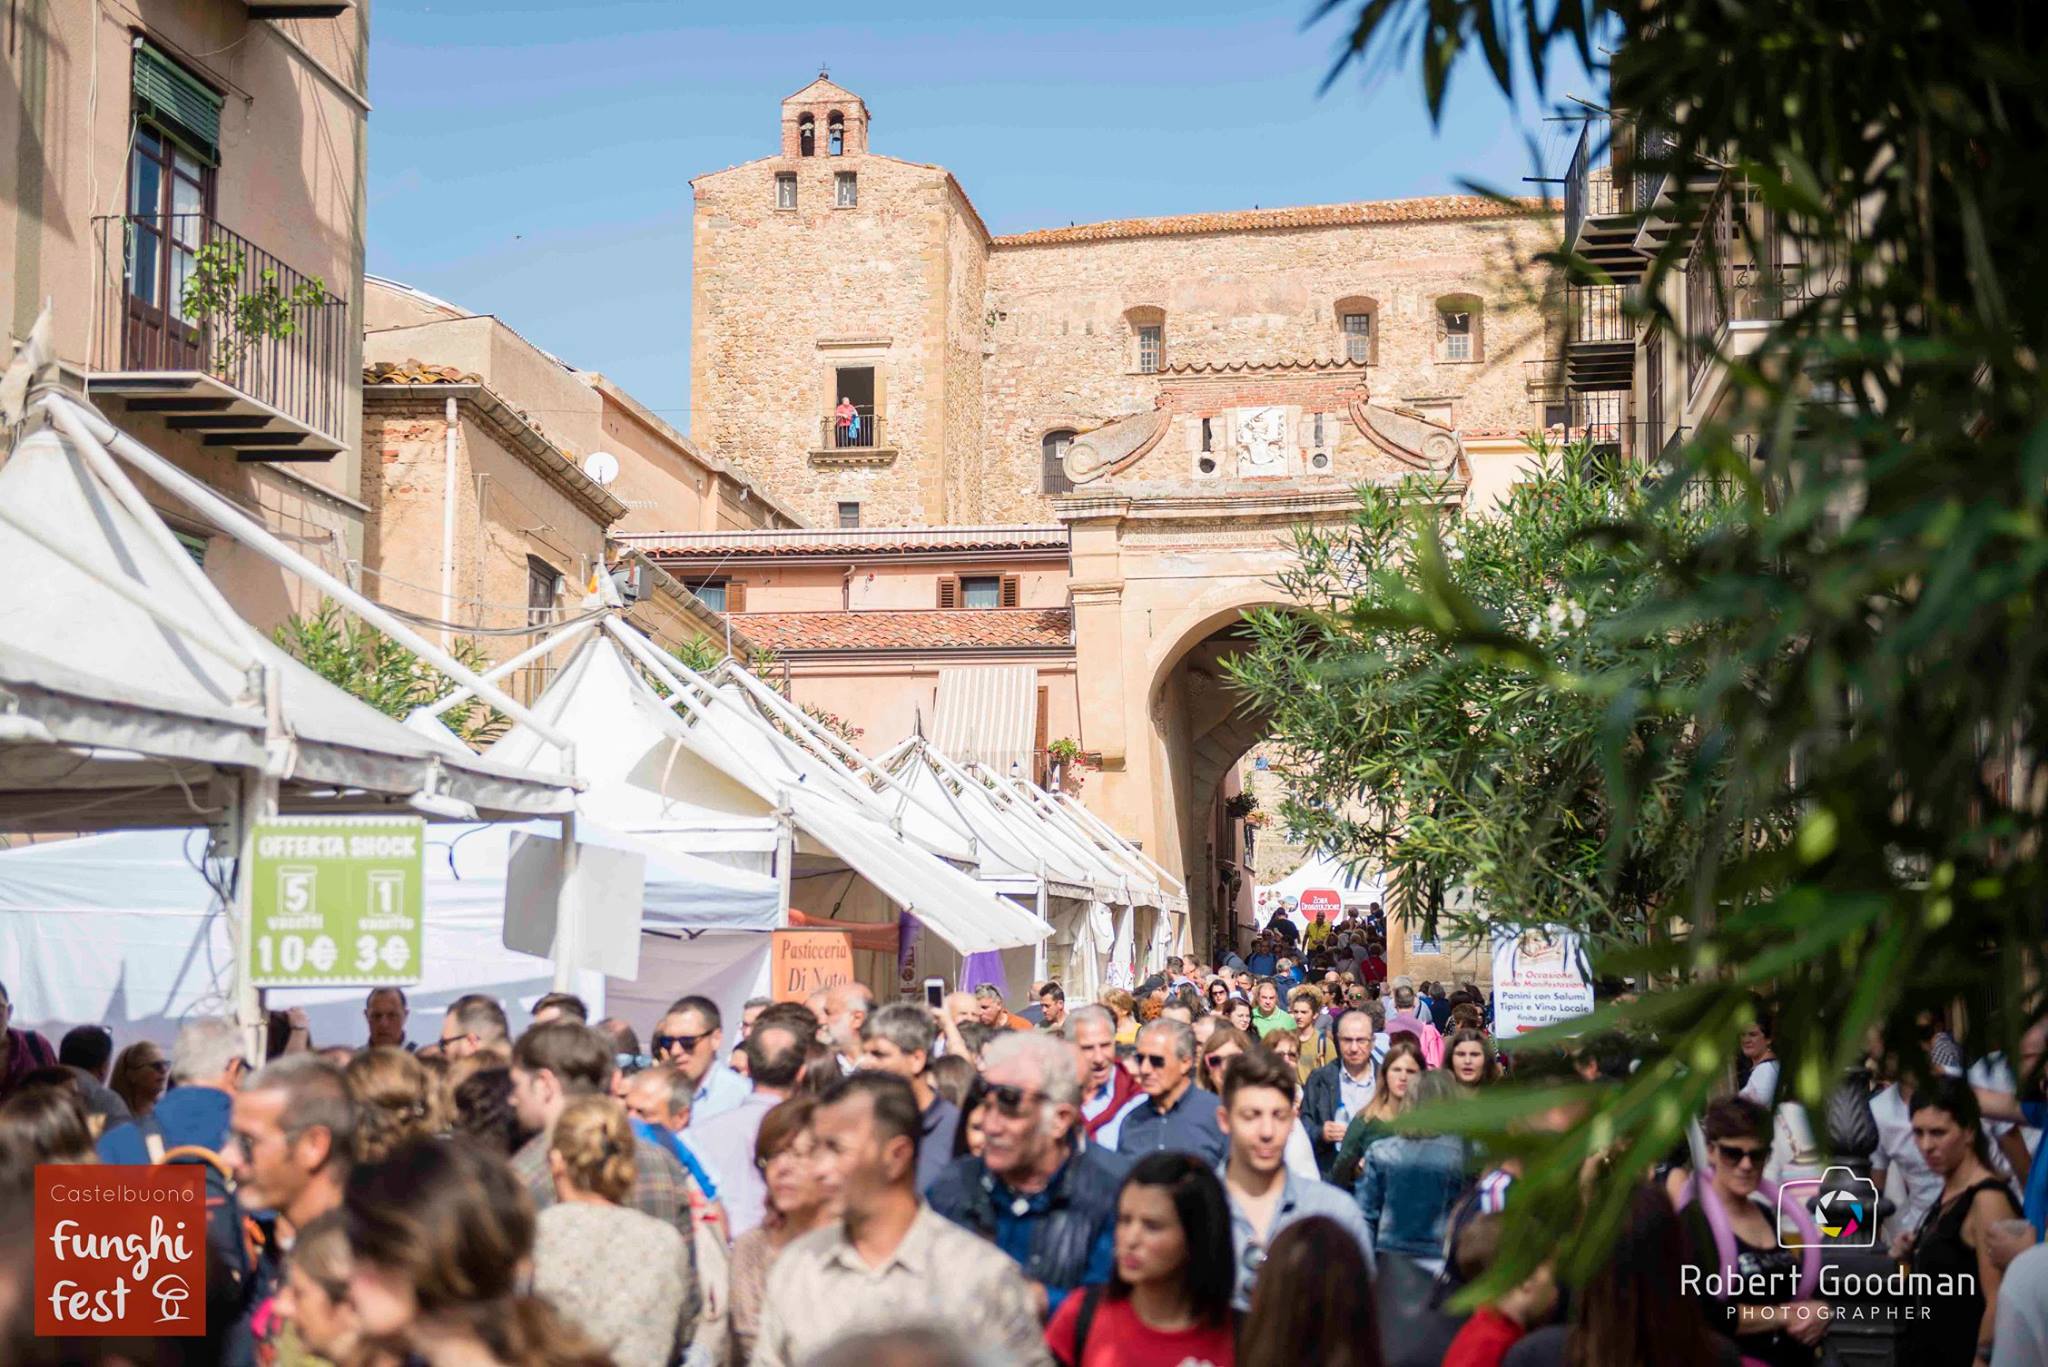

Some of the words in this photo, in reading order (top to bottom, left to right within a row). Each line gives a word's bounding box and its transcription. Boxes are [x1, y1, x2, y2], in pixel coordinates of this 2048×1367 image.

[258, 835, 347, 858] OFFERTA
[350, 835, 416, 858] SHOCK
[285, 876, 309, 913] 5
[378, 880, 392, 913] 1
[258, 935, 338, 973] 10€
[355, 935, 411, 972] 3€
[781, 939, 847, 960] Pasticceria
[788, 967, 807, 992] Di
[1500, 1002, 1524, 1012] Tipici
[1535, 1003, 1557, 1012] Vino
[1560, 1004, 1590, 1013] Locale
[1502, 991, 1532, 1000] Panini
[1554, 992, 1586, 1000] Salumi
